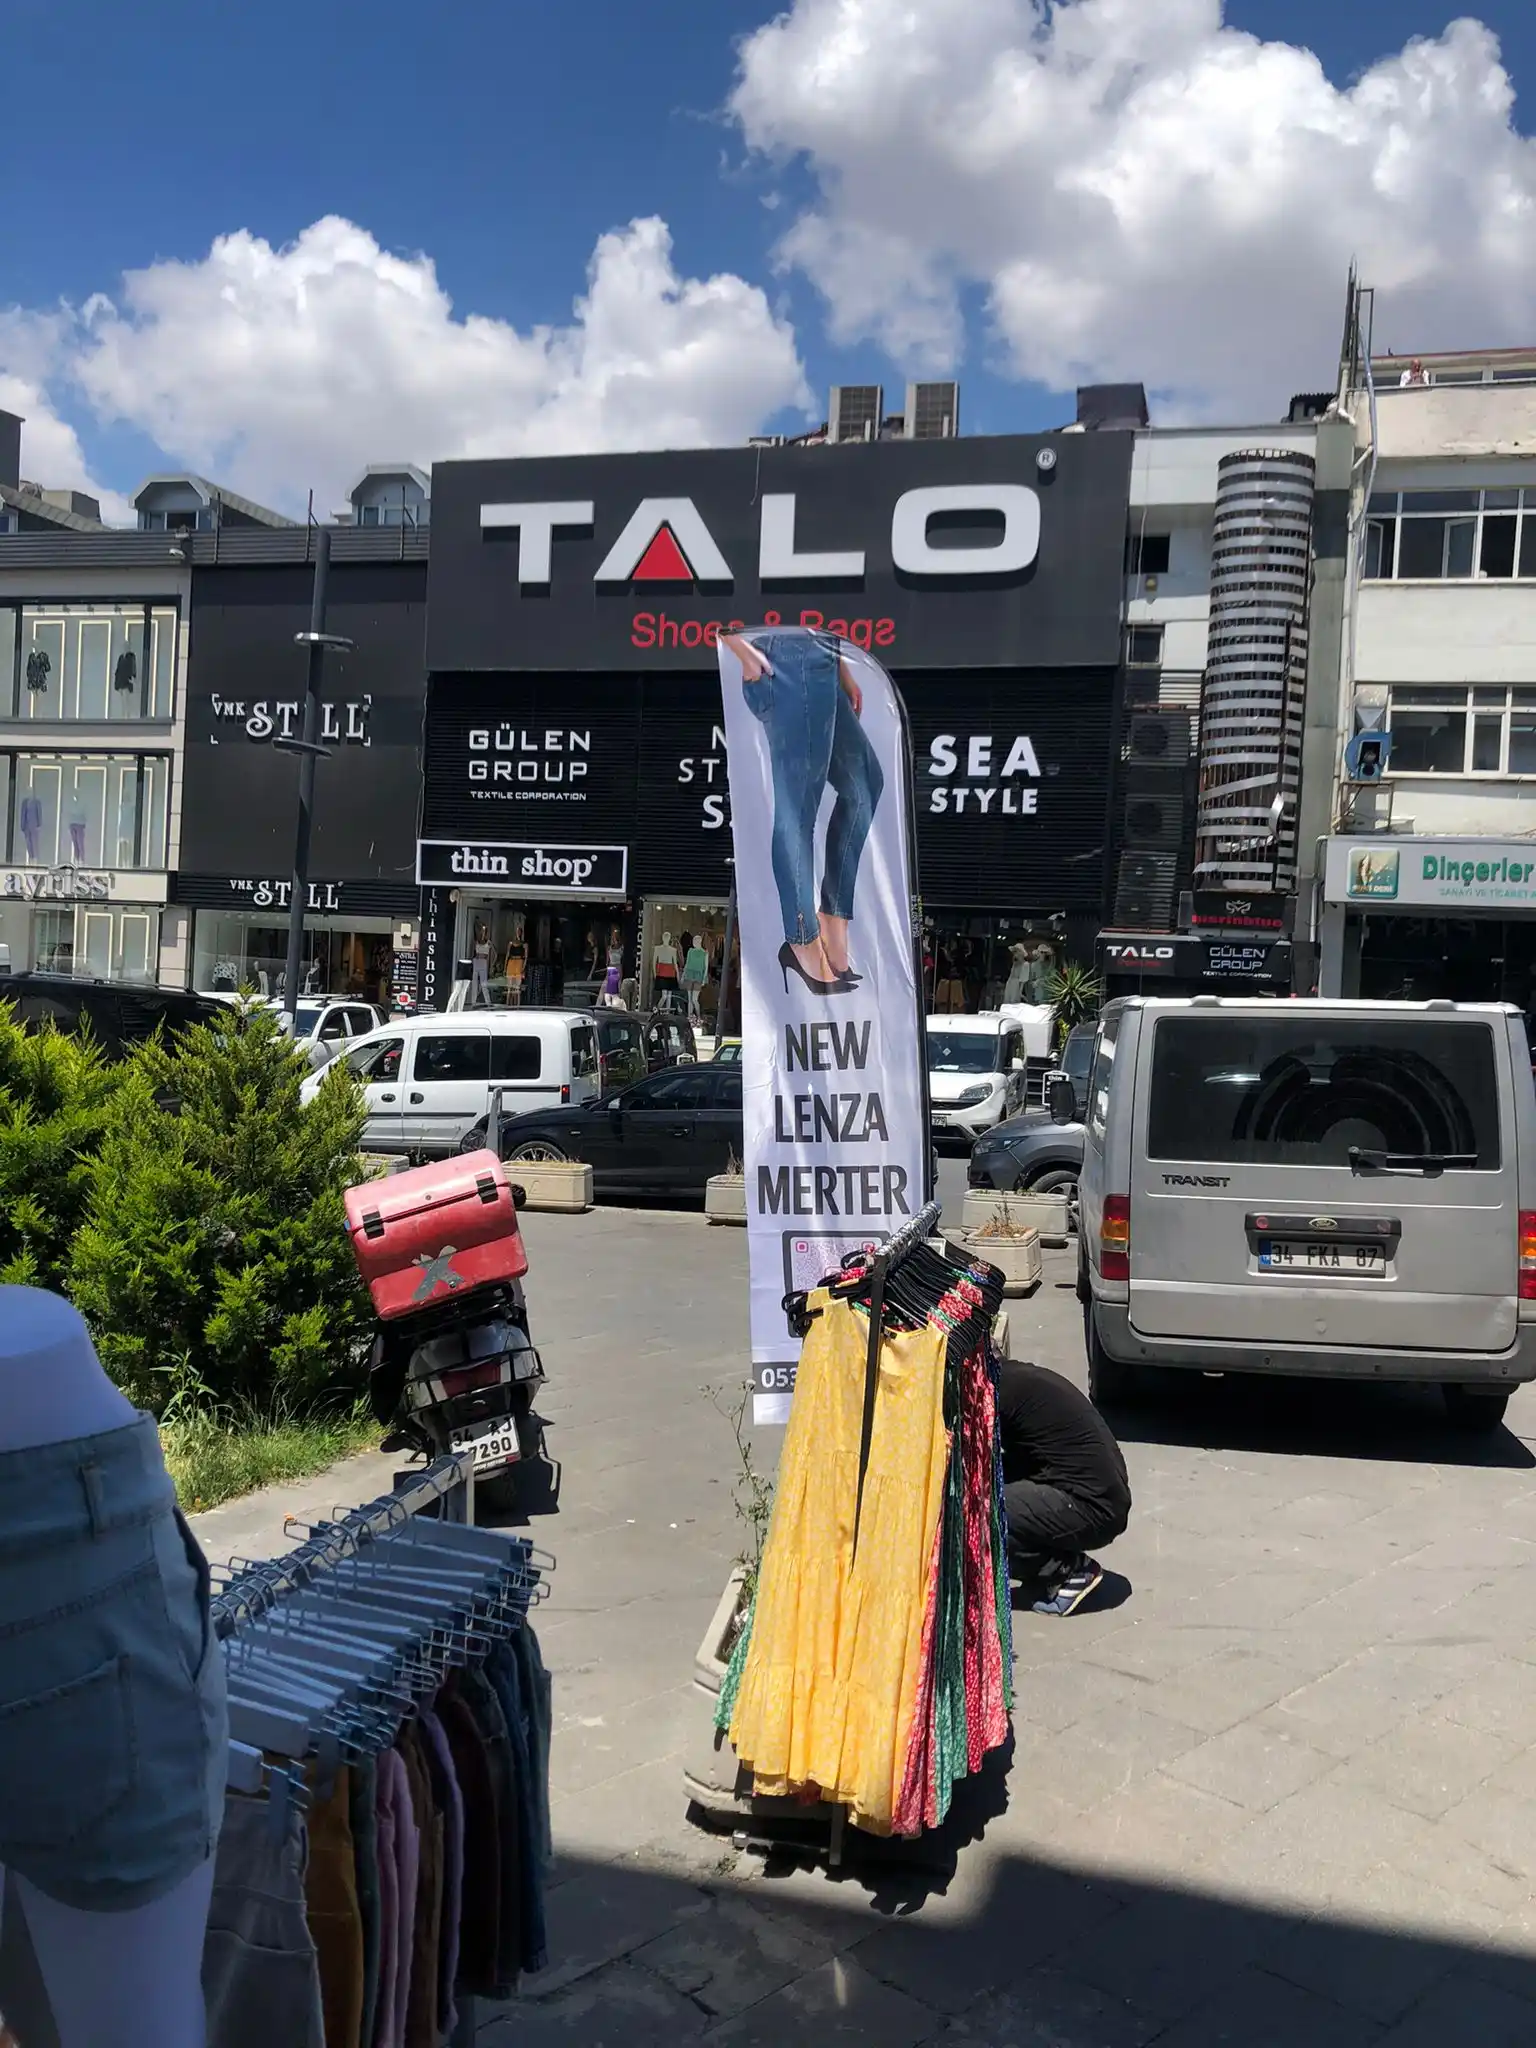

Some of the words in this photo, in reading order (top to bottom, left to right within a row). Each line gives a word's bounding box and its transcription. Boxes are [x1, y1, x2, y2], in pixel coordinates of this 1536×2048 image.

[480, 484, 1041, 583] TALO
[245, 701, 364, 739] STLL
[469, 723, 591, 751] GÜLEN
[929, 735, 1041, 777] SEA
[469, 760, 588, 782] GROUP
[470, 790, 513, 800] TEXTILE
[515, 791, 587, 801] CORPORATION
[929, 788, 1038, 814] STYLE
[451, 847, 509, 874] thin
[521, 849, 593, 885] shop
[253, 880, 339, 910] STLL
[1106, 945, 1174, 958] TALO
[1209, 945, 1266, 958] GÜLEN
[1210, 959, 1263, 971] GROUP
[785, 1020, 872, 1072] NEW
[774, 1093, 889, 1143] LENZA
[757, 1164, 911, 1216] MERTER
[1162, 1174, 1231, 1188] TRANSIT
[1272, 1245, 1294, 1266] 34
[1307, 1246, 1341, 1267] FKA
[452, 1427, 474, 1447] 34
[468, 1436, 512, 1462] 7290
